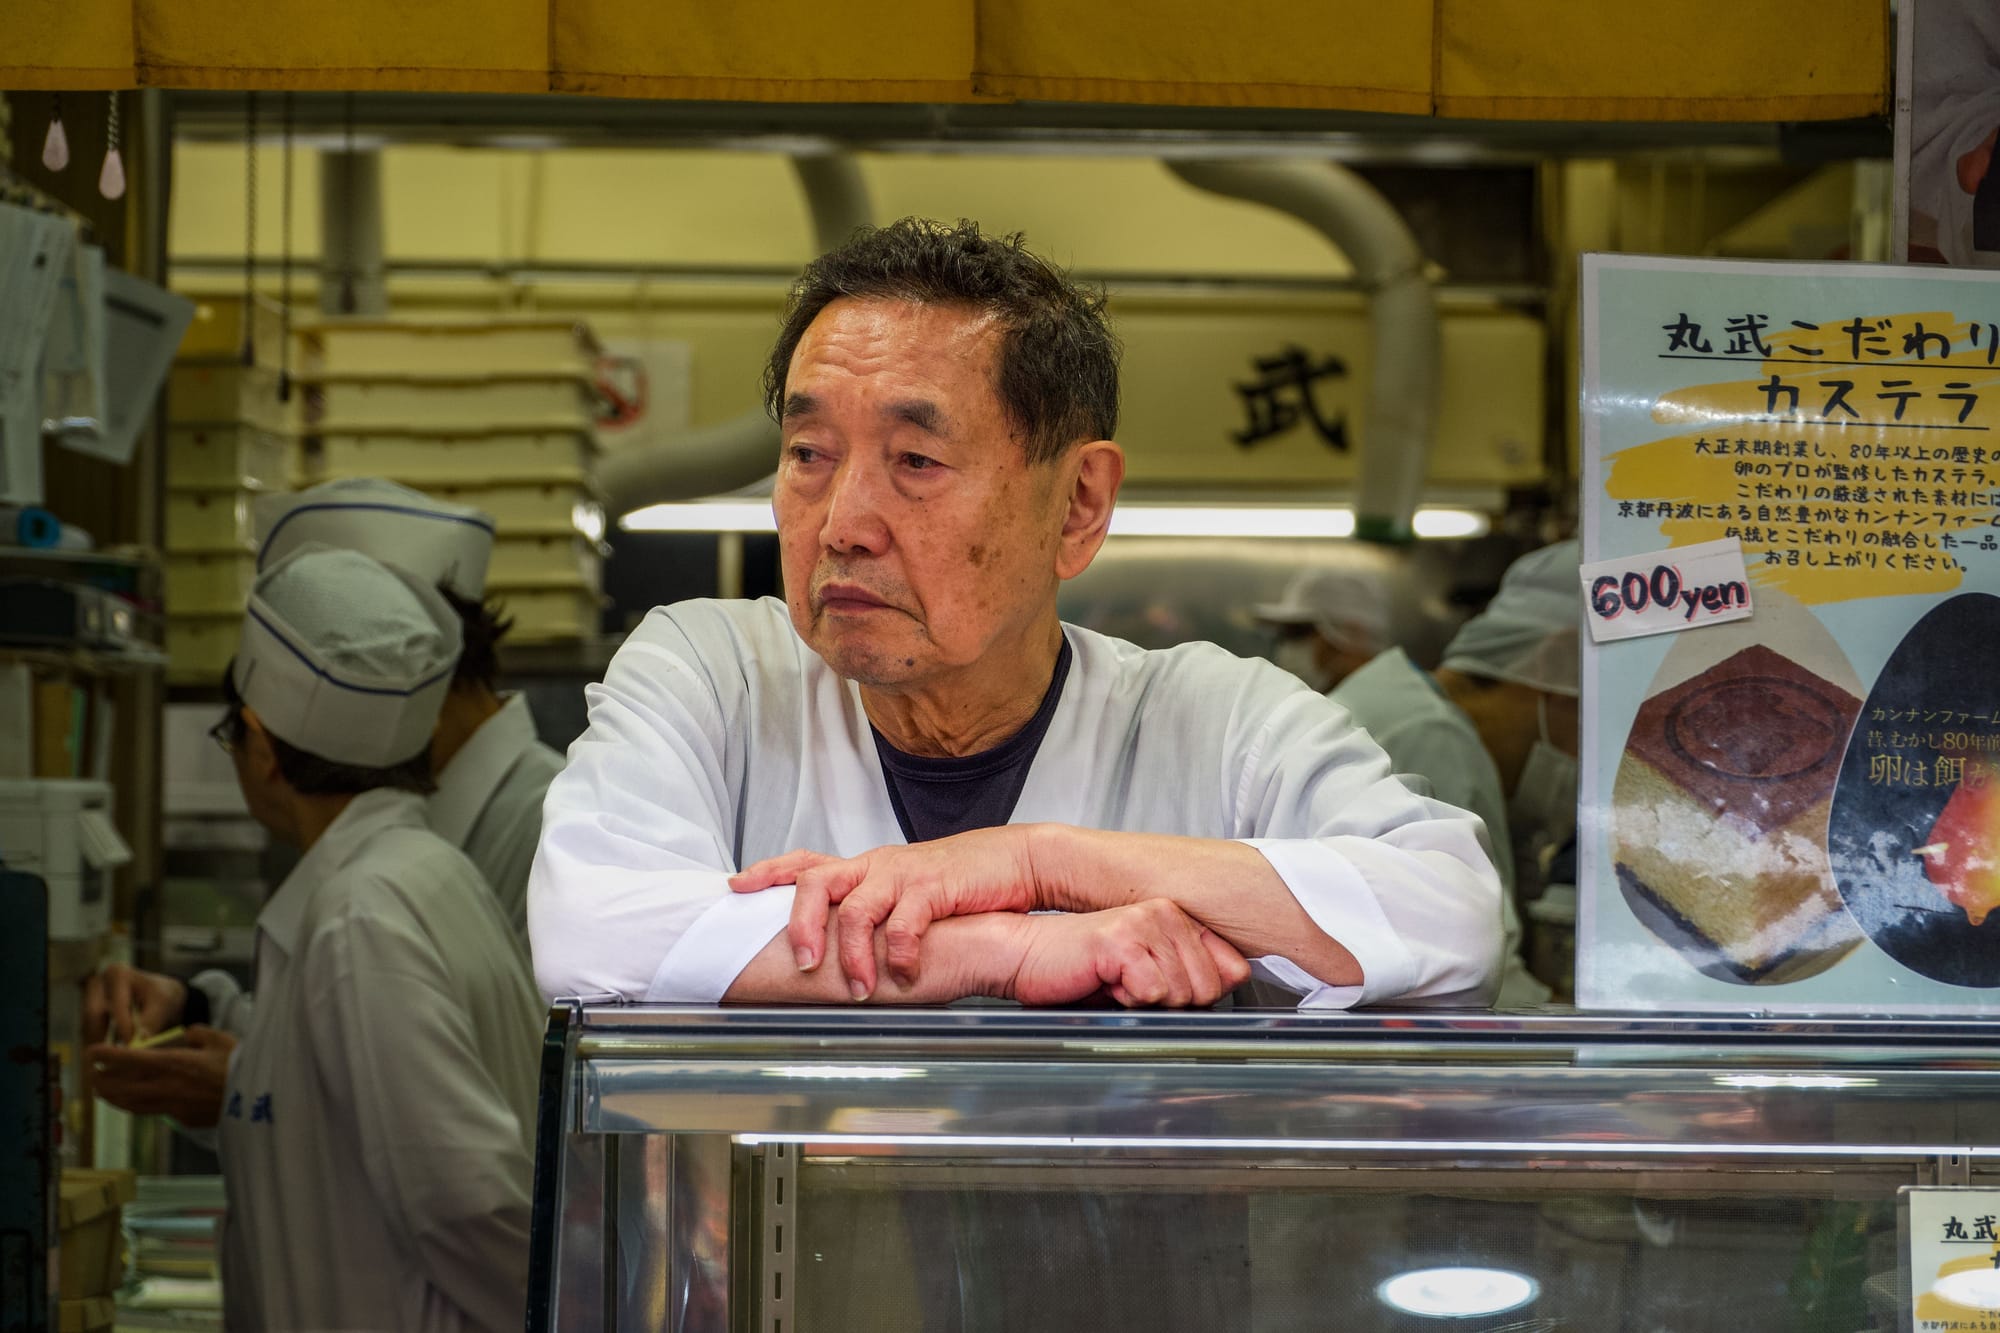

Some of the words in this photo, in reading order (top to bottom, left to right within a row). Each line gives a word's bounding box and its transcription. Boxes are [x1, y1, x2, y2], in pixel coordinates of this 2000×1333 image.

[1661, 312, 1999, 365] 丸武こだわり
[1230, 344, 1350, 453] 武
[1757, 374, 1978, 424] カステラ
[1734, 460, 1996, 487] 卵のプロが監修したカステラ。
[1764, 549, 1969, 573] お召し上がりください。
[1591, 564, 1750, 622] 600yen
[1942, 1215, 1998, 1241] 丸武
